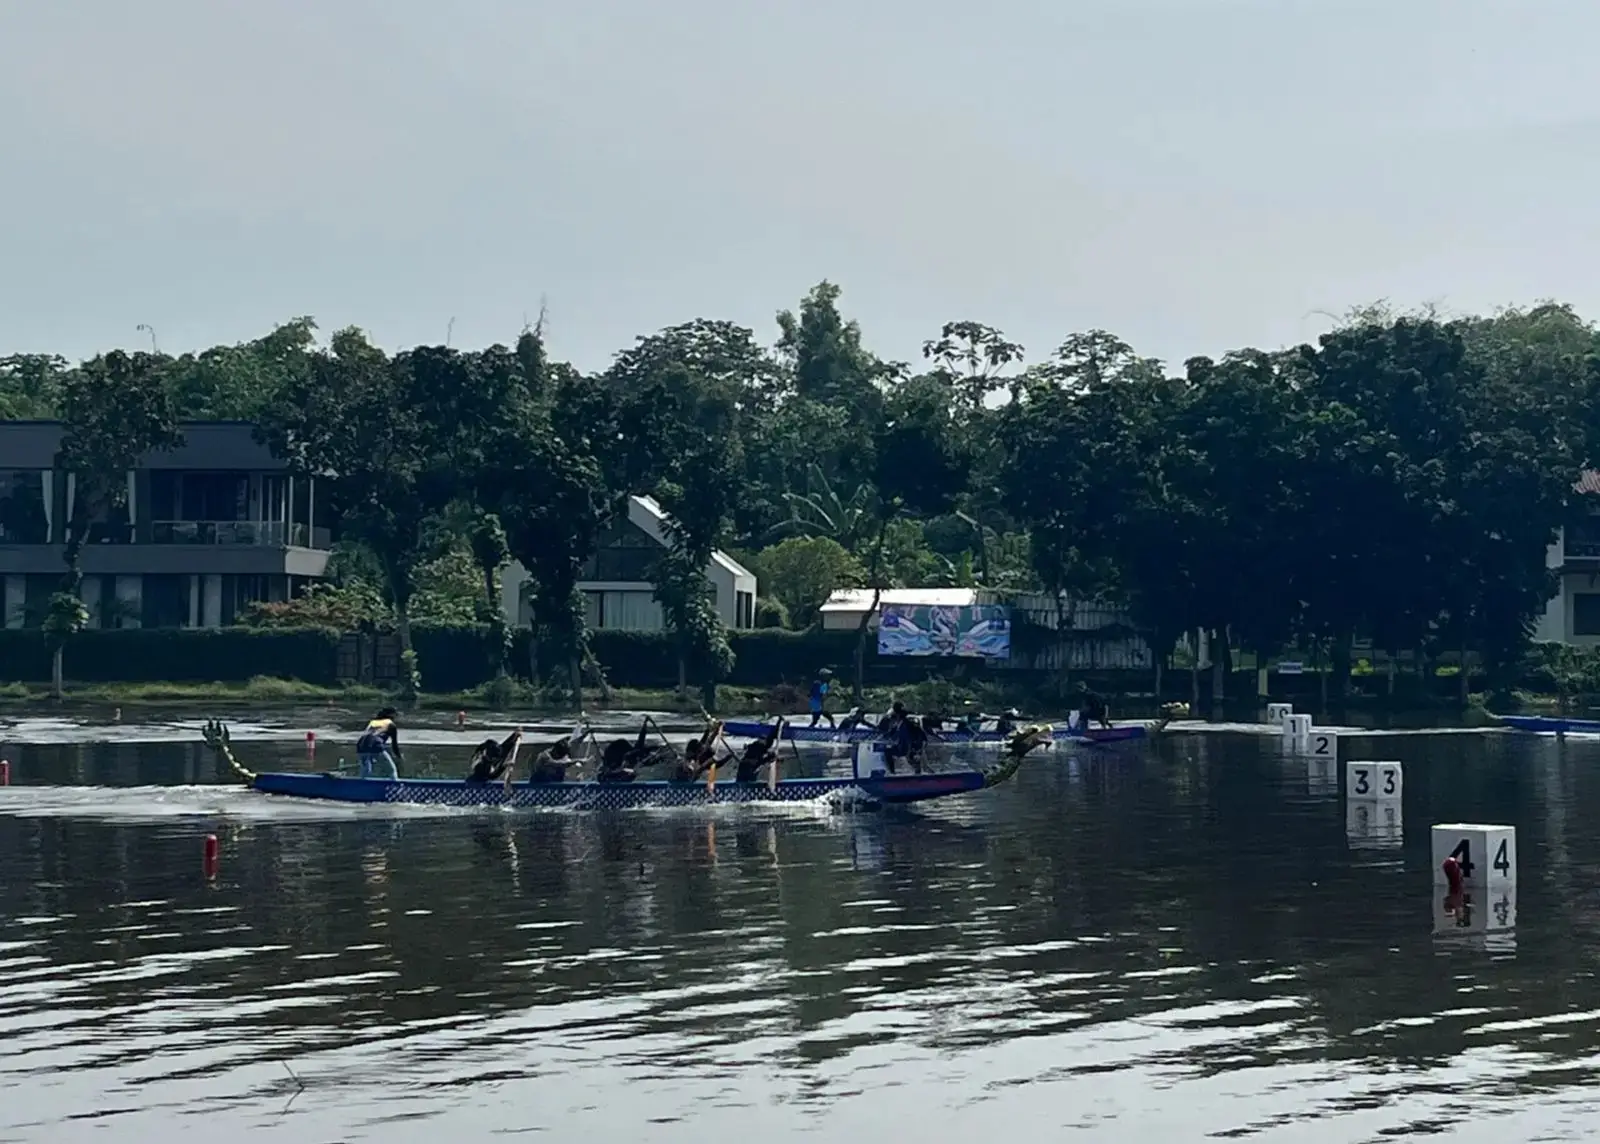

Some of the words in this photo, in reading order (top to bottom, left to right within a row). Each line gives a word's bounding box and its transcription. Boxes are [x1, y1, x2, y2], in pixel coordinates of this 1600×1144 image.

[1290, 720, 1296, 733] 1
[1315, 737, 1329, 754] 2
[1355, 770, 1369, 794] 3
[1384, 770, 1395, 794] 3
[1448, 839, 1475, 878] 4
[1494, 838, 1510, 877] 4
